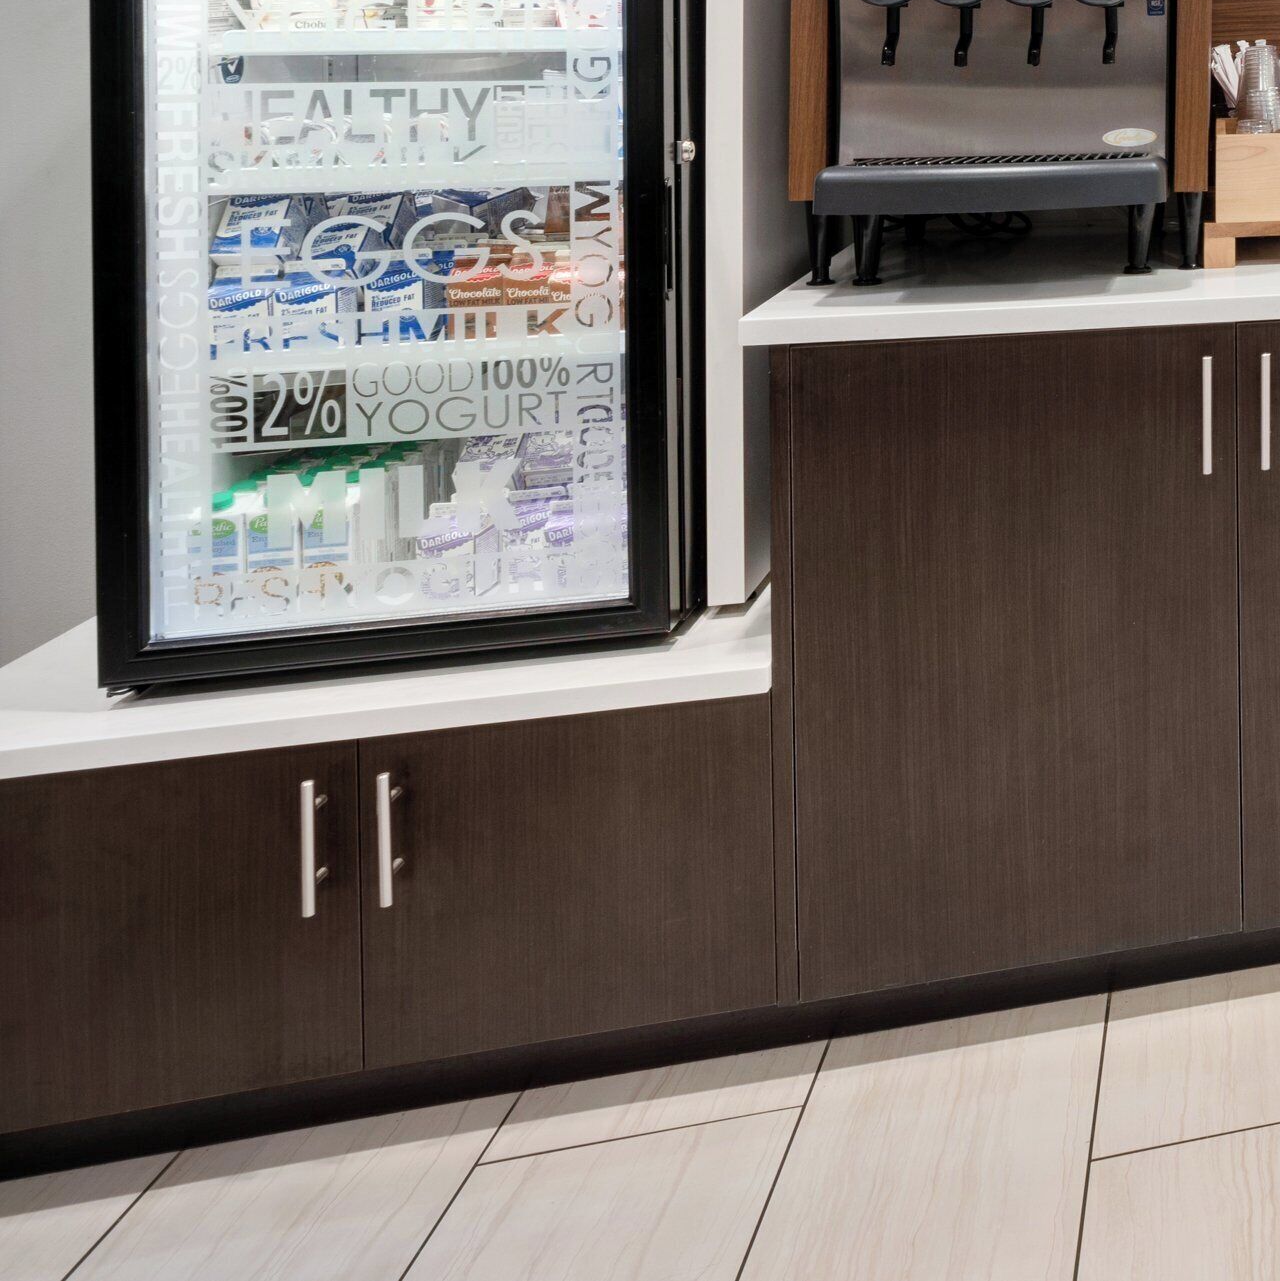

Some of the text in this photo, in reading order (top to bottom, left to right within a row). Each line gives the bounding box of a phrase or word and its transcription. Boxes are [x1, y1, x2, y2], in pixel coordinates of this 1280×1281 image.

[241, 210, 544, 289] EGGS
[208, 290, 264, 310] DARIGOLD
[278, 284, 331, 303] DARIGOLD
[448, 286, 502, 300] Chocolate
[352, 355, 571, 398] GOOD 100%
[208, 374, 248, 450] 100%
[260, 370, 342, 438] 2%
[354, 389, 568, 438] YOGURT
[266, 459, 518, 548] MILK
